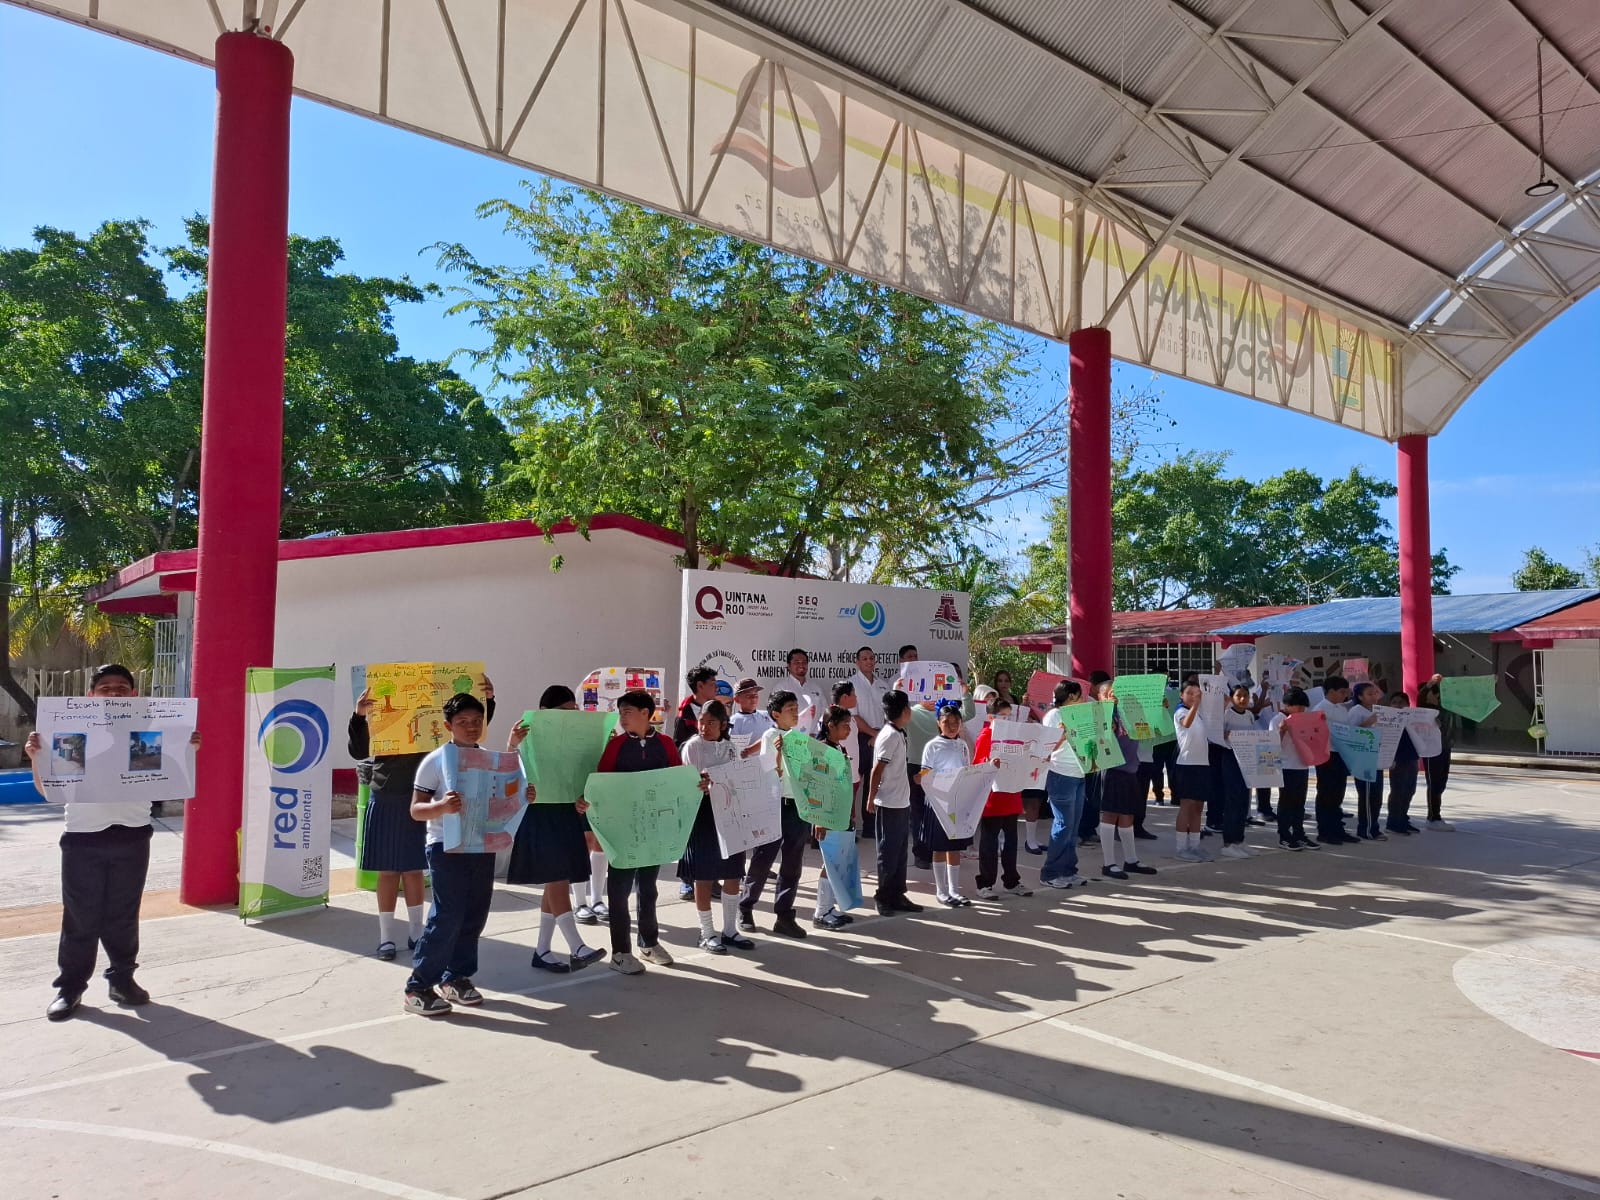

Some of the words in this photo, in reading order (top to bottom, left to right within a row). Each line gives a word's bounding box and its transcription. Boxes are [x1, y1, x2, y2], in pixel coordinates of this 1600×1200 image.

[797, 595, 819, 606] SEQ
[725, 604, 745, 616] ROO
[839, 604, 858, 615] red
[929, 629, 964, 640] TULUM
[752, 649, 776, 661] CIERRE
[268, 786, 298, 850] red
[302, 789, 312, 849] ambiental
